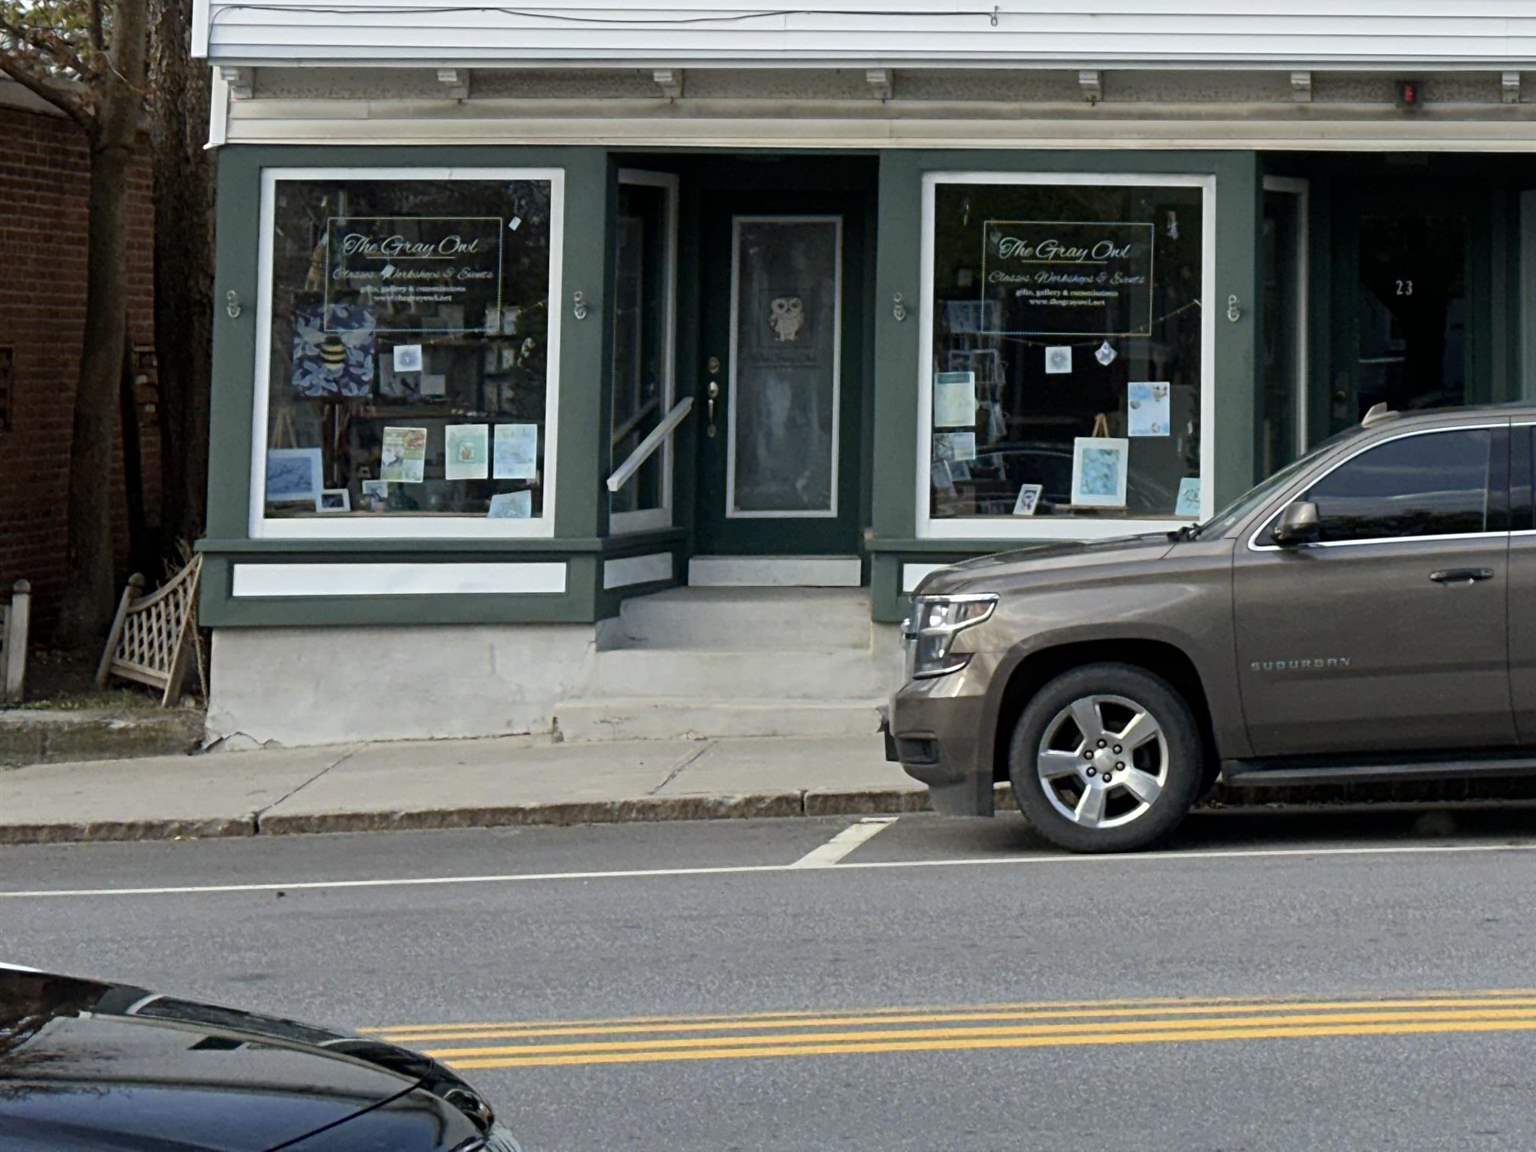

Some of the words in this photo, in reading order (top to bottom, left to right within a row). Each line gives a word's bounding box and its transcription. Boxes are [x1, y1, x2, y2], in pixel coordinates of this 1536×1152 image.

[343, 233, 379, 255] The
[381, 235, 436, 258] Gray
[438, 235, 480, 255] Owl
[999, 237, 1034, 259] The
[1035, 239, 1089, 262] Gray
[1091, 240, 1131, 260] Owl
[1395, 279, 1413, 295] 23
[1250, 657, 1353, 671] SUBURBAN
